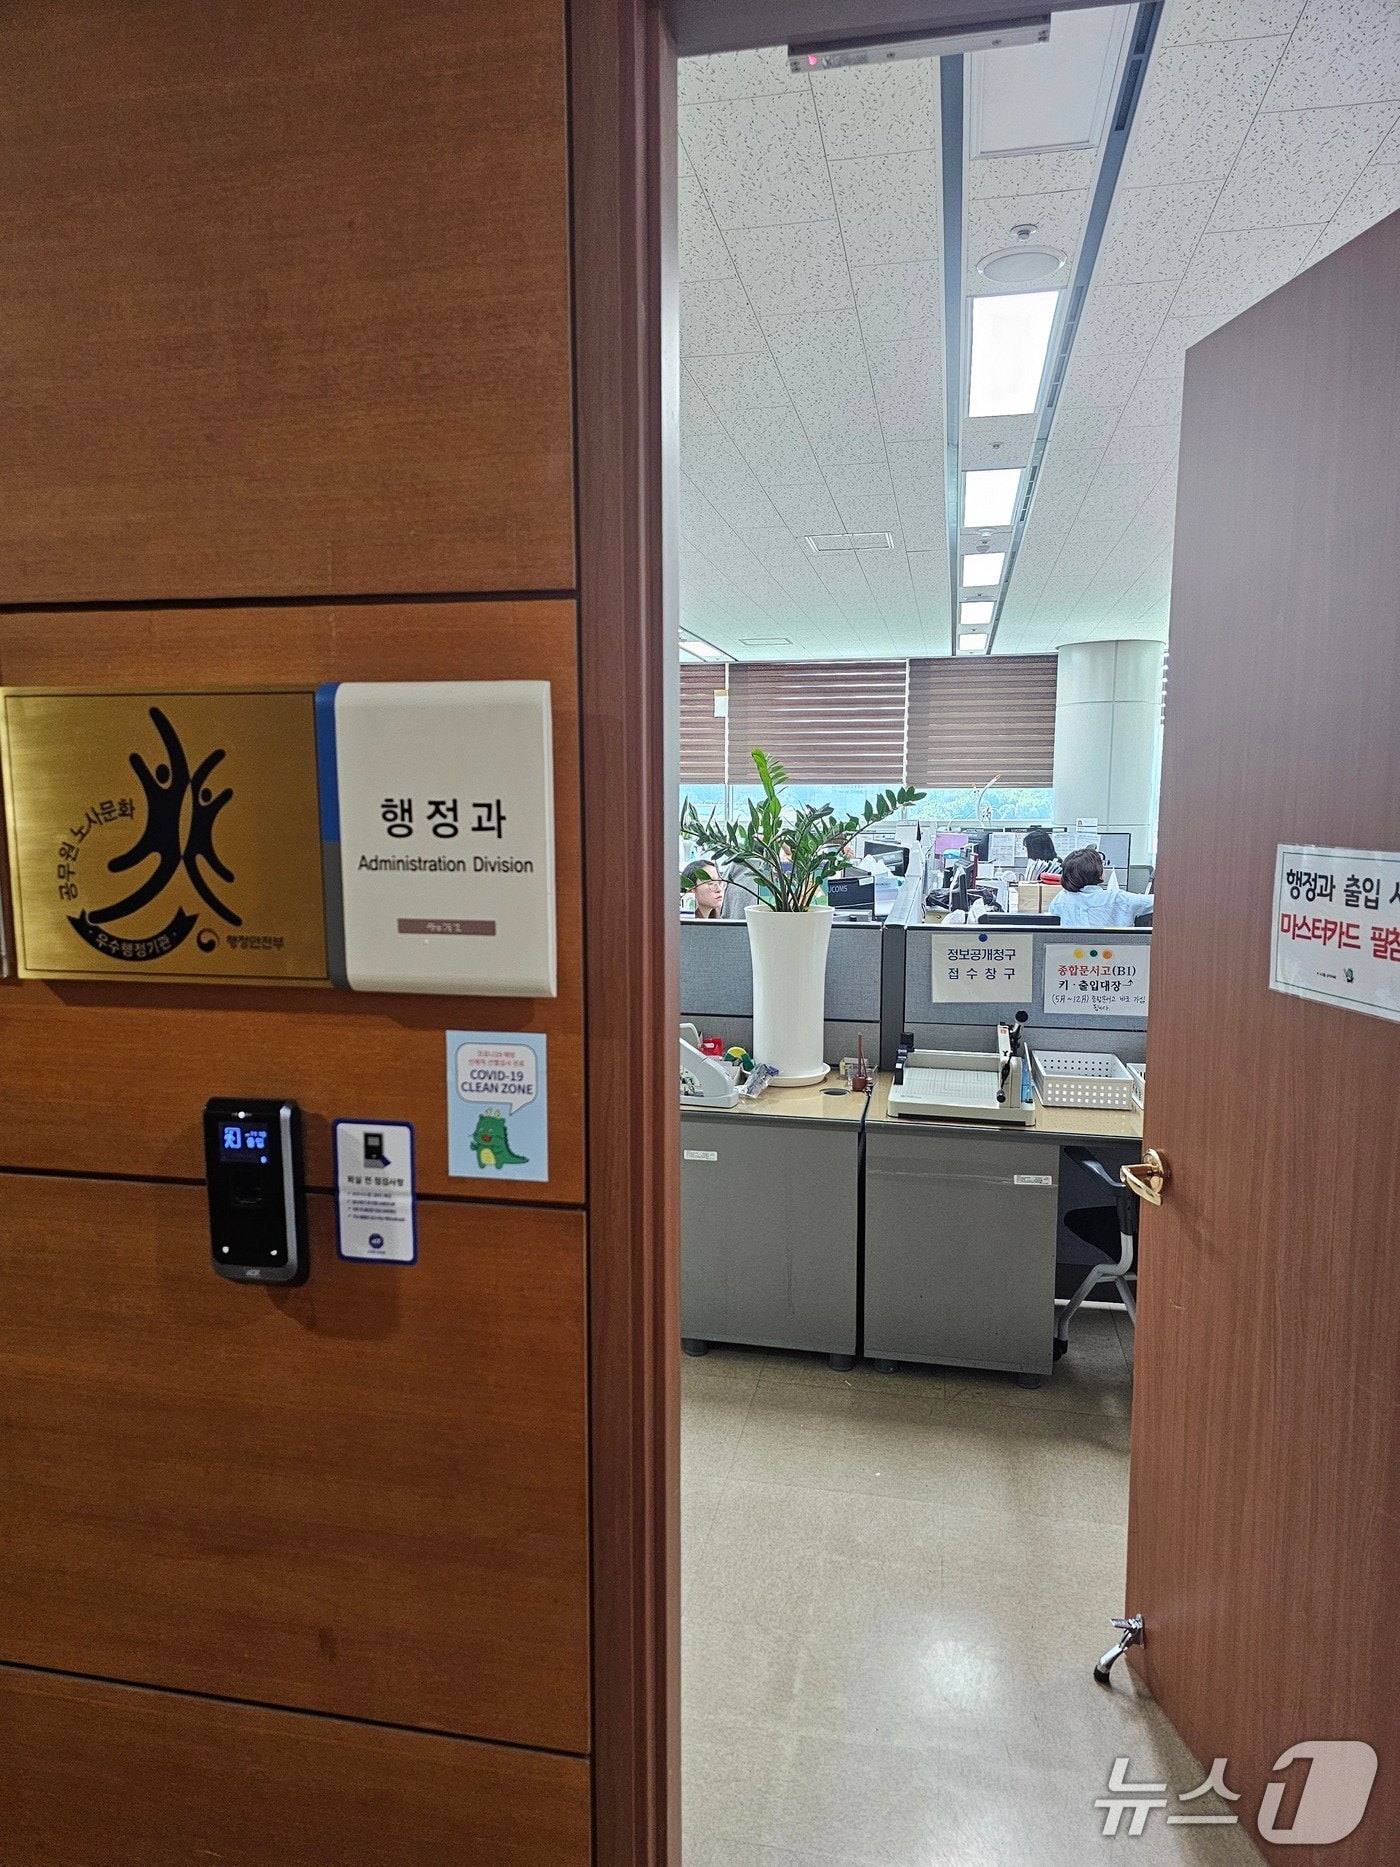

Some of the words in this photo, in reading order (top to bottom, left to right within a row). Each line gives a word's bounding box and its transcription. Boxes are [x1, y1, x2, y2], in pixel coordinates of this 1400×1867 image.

[381, 798, 507, 840] 행정과
[57, 842, 80, 901] 공무원
[70, 798, 136, 843] 노사문화
[357, 854, 467, 873] Administration
[473, 856, 534, 874] Division
[1286, 868, 1336, 902] 행정과
[1343, 874, 1381, 910] 출입
[1280, 912, 1361, 950] 마스터카드
[94, 932, 174, 958] 우수행정기관
[226, 934, 285, 952] 행정안전부
[947, 948, 1017, 962] 정보공개청구
[1057, 965, 1137, 977] 종합문서고(B1)
[1078, 979, 1122, 992] 출입대장
[470, 1069, 524, 1082] COVID-19
[460, 1081, 499, 1093] CLEAN
[501, 1083, 534, 1095] ZONE
